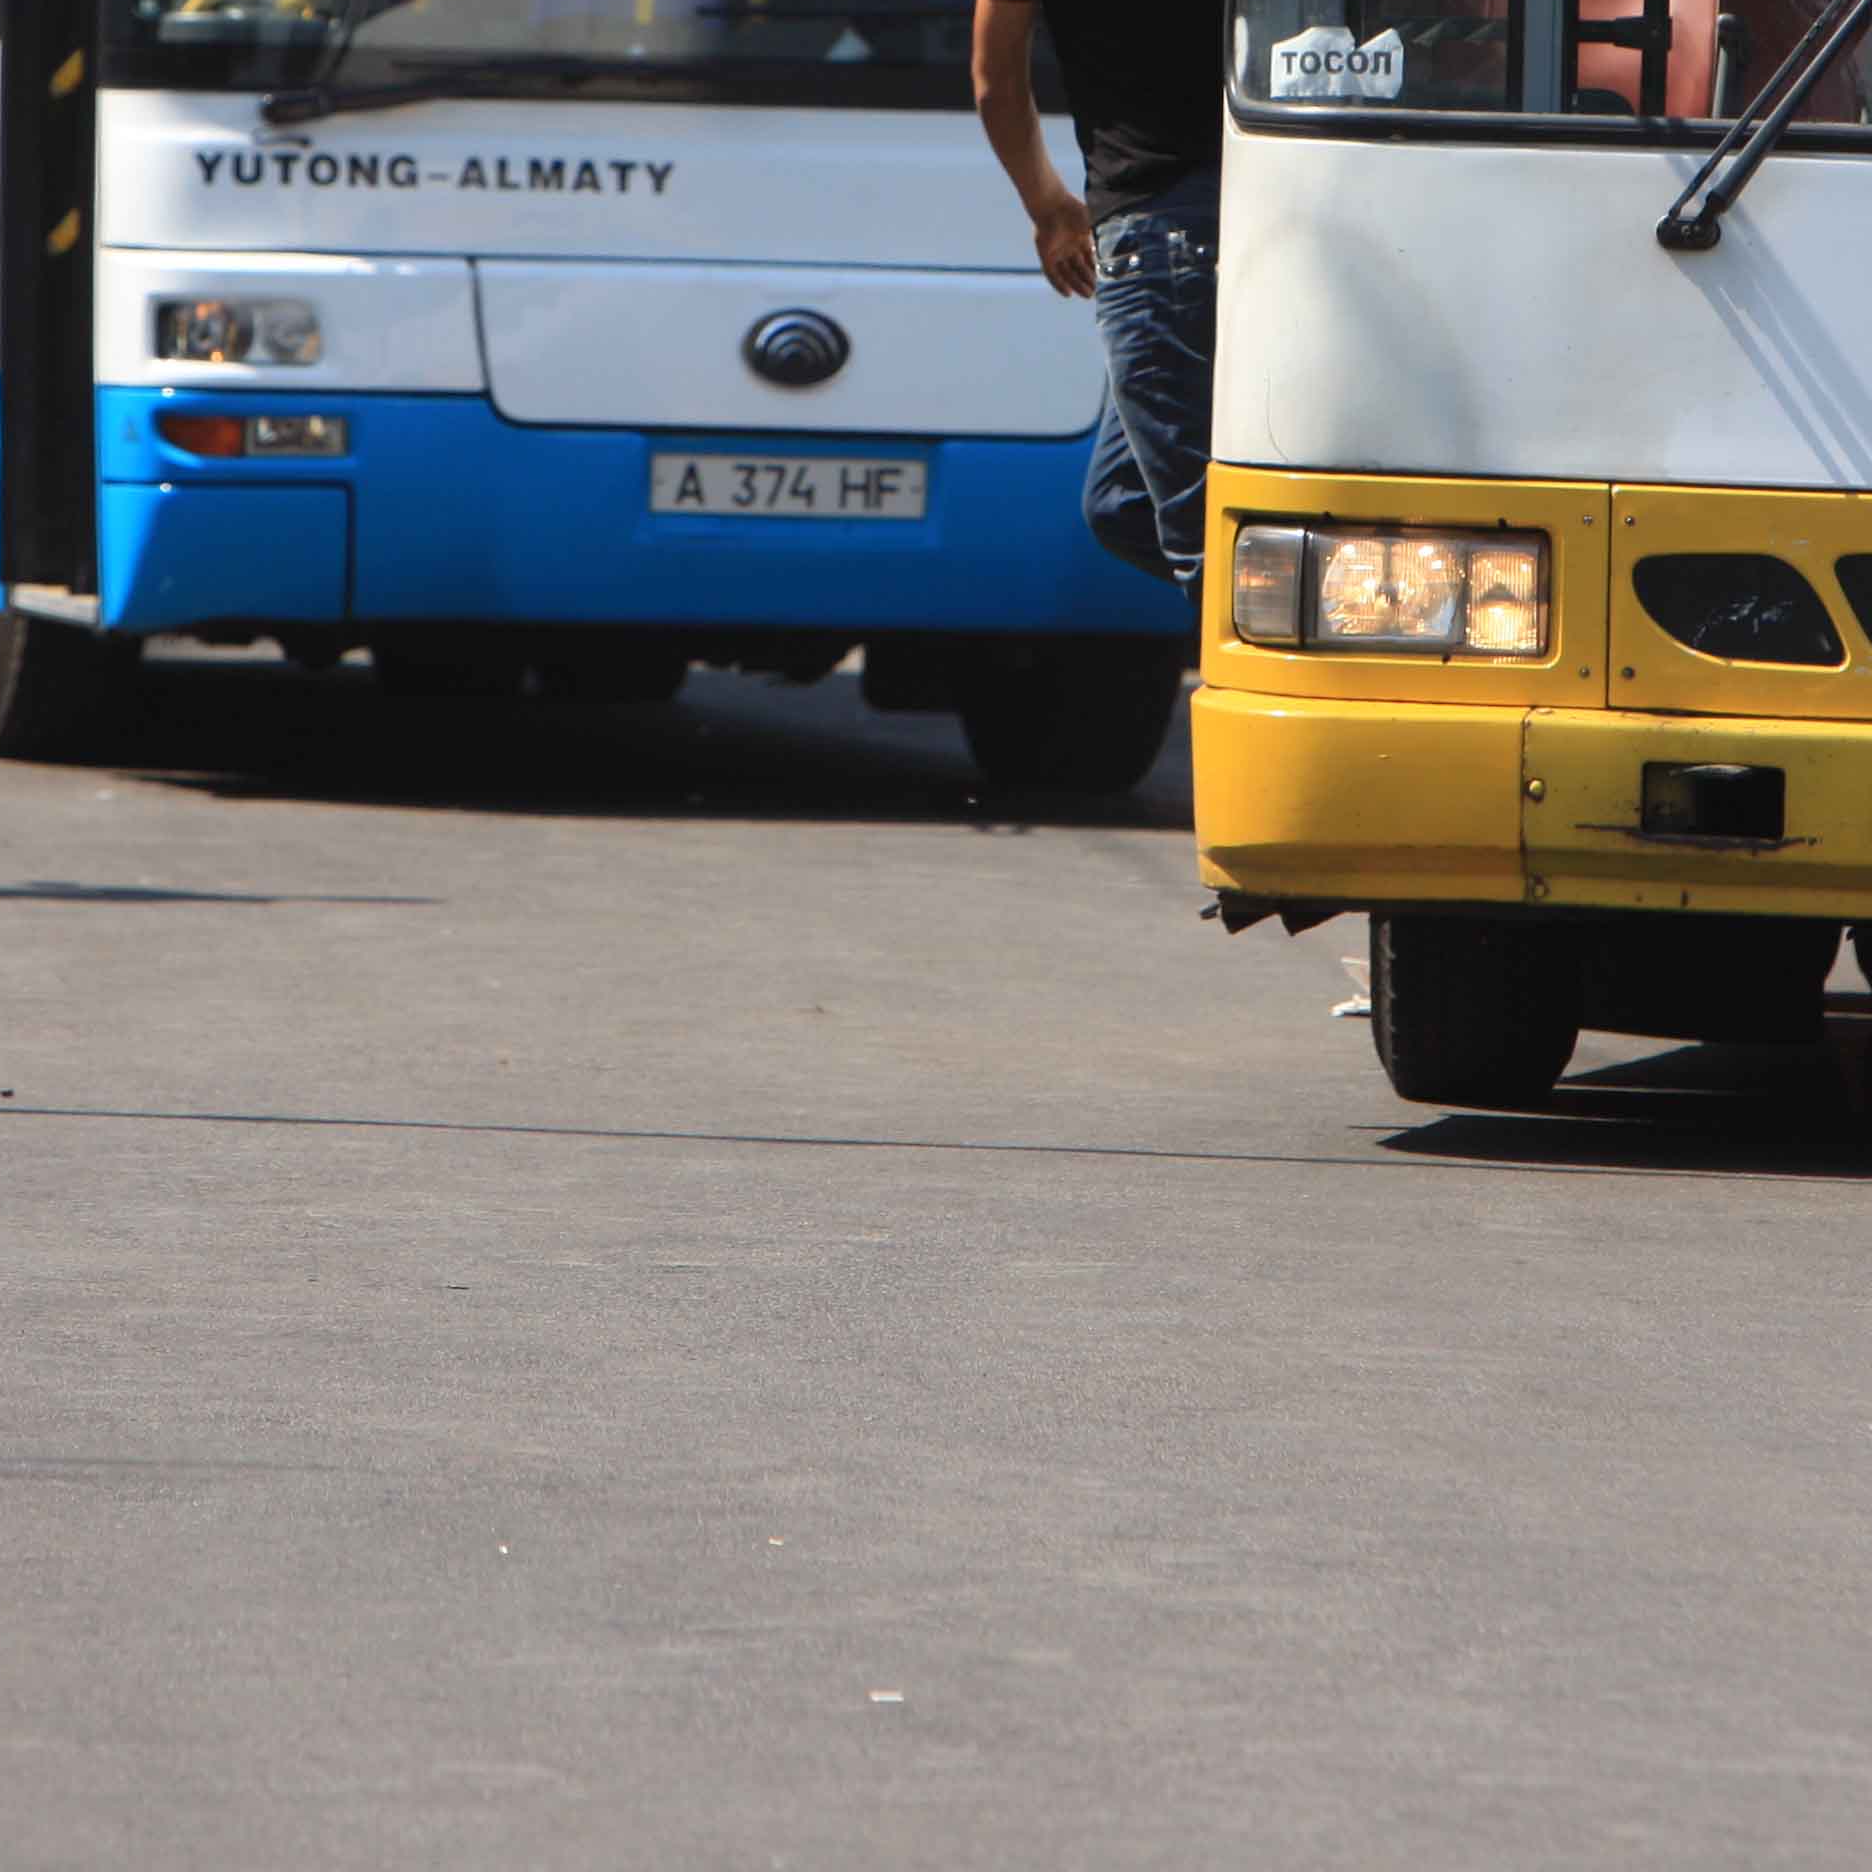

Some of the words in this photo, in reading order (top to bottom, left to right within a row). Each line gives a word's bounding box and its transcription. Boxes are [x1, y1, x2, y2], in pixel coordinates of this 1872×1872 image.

[1280, 50, 1392, 75] ТОСОЛ
[676, 462, 705, 505] A
[731, 463, 815, 508] 374
[839, 466, 904, 509] HF
